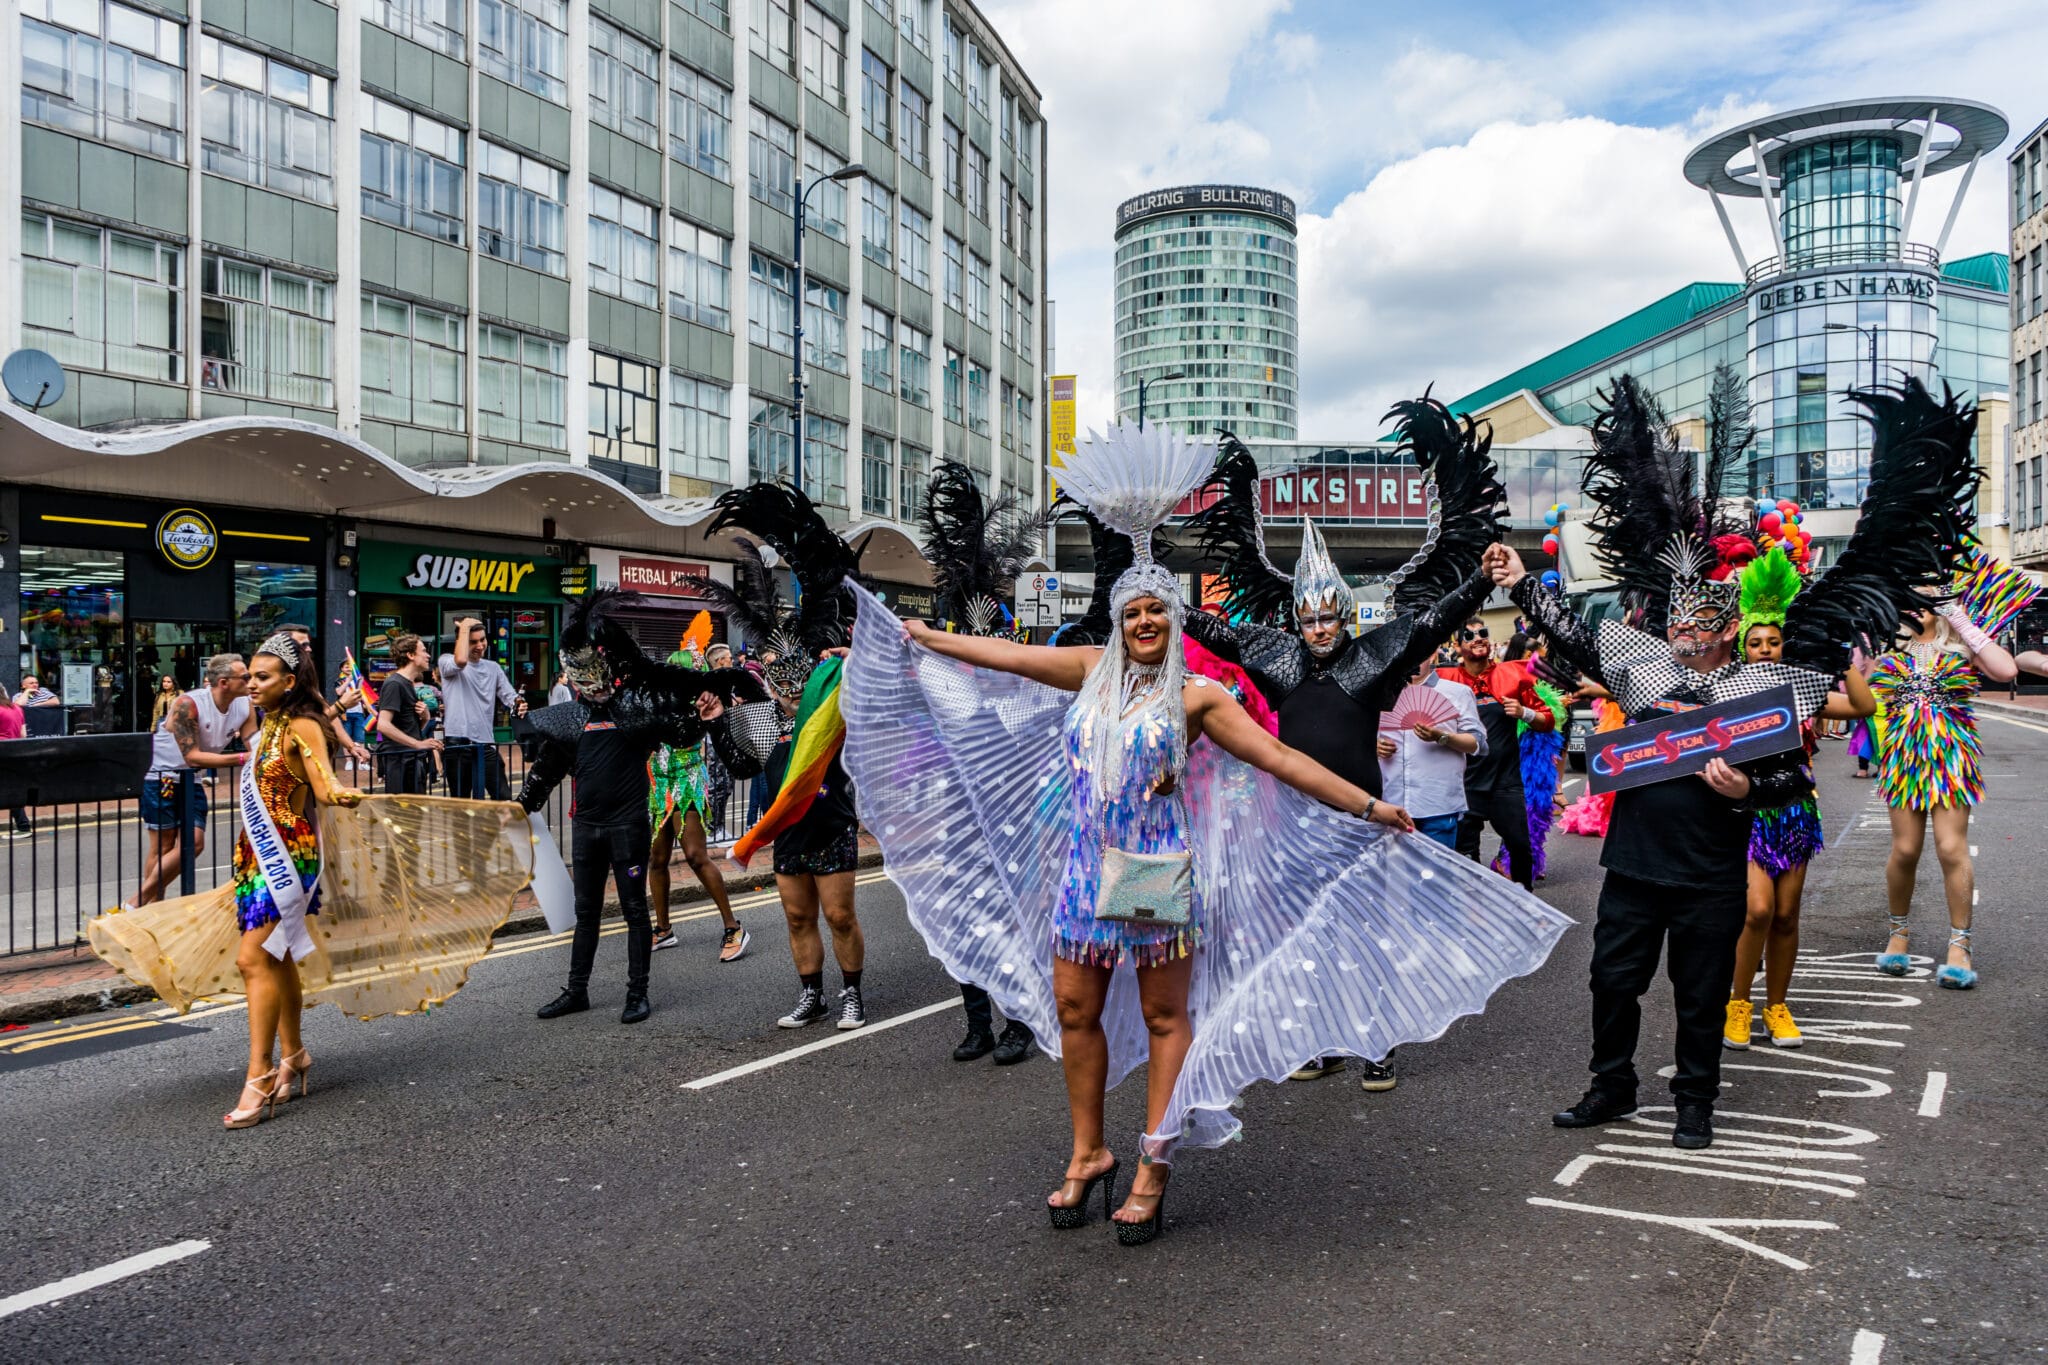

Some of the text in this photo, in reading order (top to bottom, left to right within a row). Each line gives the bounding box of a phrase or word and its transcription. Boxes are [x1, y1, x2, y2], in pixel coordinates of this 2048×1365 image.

[1124, 191, 1184, 218] BULLRING
[1201, 189, 1273, 208] BULLRING
[1760, 277, 1934, 311] DEBENHAMS
[1057, 432, 1070, 441] TO
[1056, 443, 1072, 452] LET
[1275, 477, 1422, 505] NKSTRE
[167, 533, 211, 545] Turkish
[406, 554, 535, 593] SUBWAY
[560, 567, 587, 575] SUBWAY
[622, 566, 668, 586] HERBAL
[560, 577, 587, 585] SUBWAY
[561, 587, 587, 595] SUBWAY
[1374, 609, 1386, 618] Ce
[1706, 713, 1782, 752] STOPPERS
[242, 783, 279, 862] BIRMINGHAM
[265, 859, 293, 890] 2018
